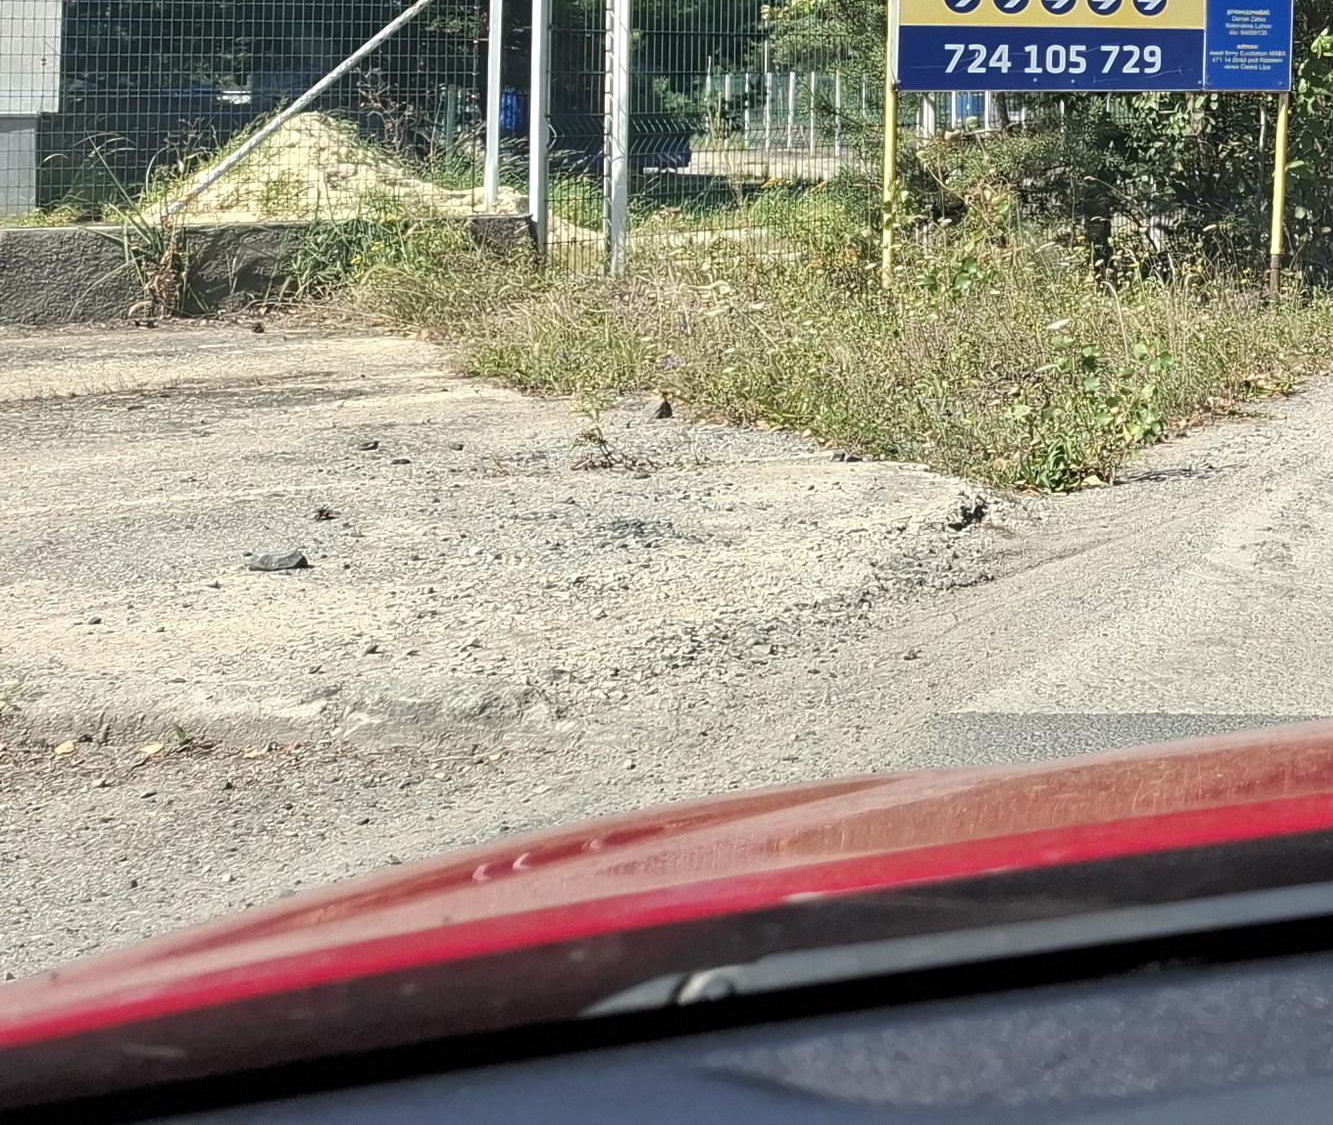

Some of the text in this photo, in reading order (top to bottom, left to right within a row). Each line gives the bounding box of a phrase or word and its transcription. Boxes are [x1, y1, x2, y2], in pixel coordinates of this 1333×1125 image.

[944, 43, 1162, 74] 724 105 729
